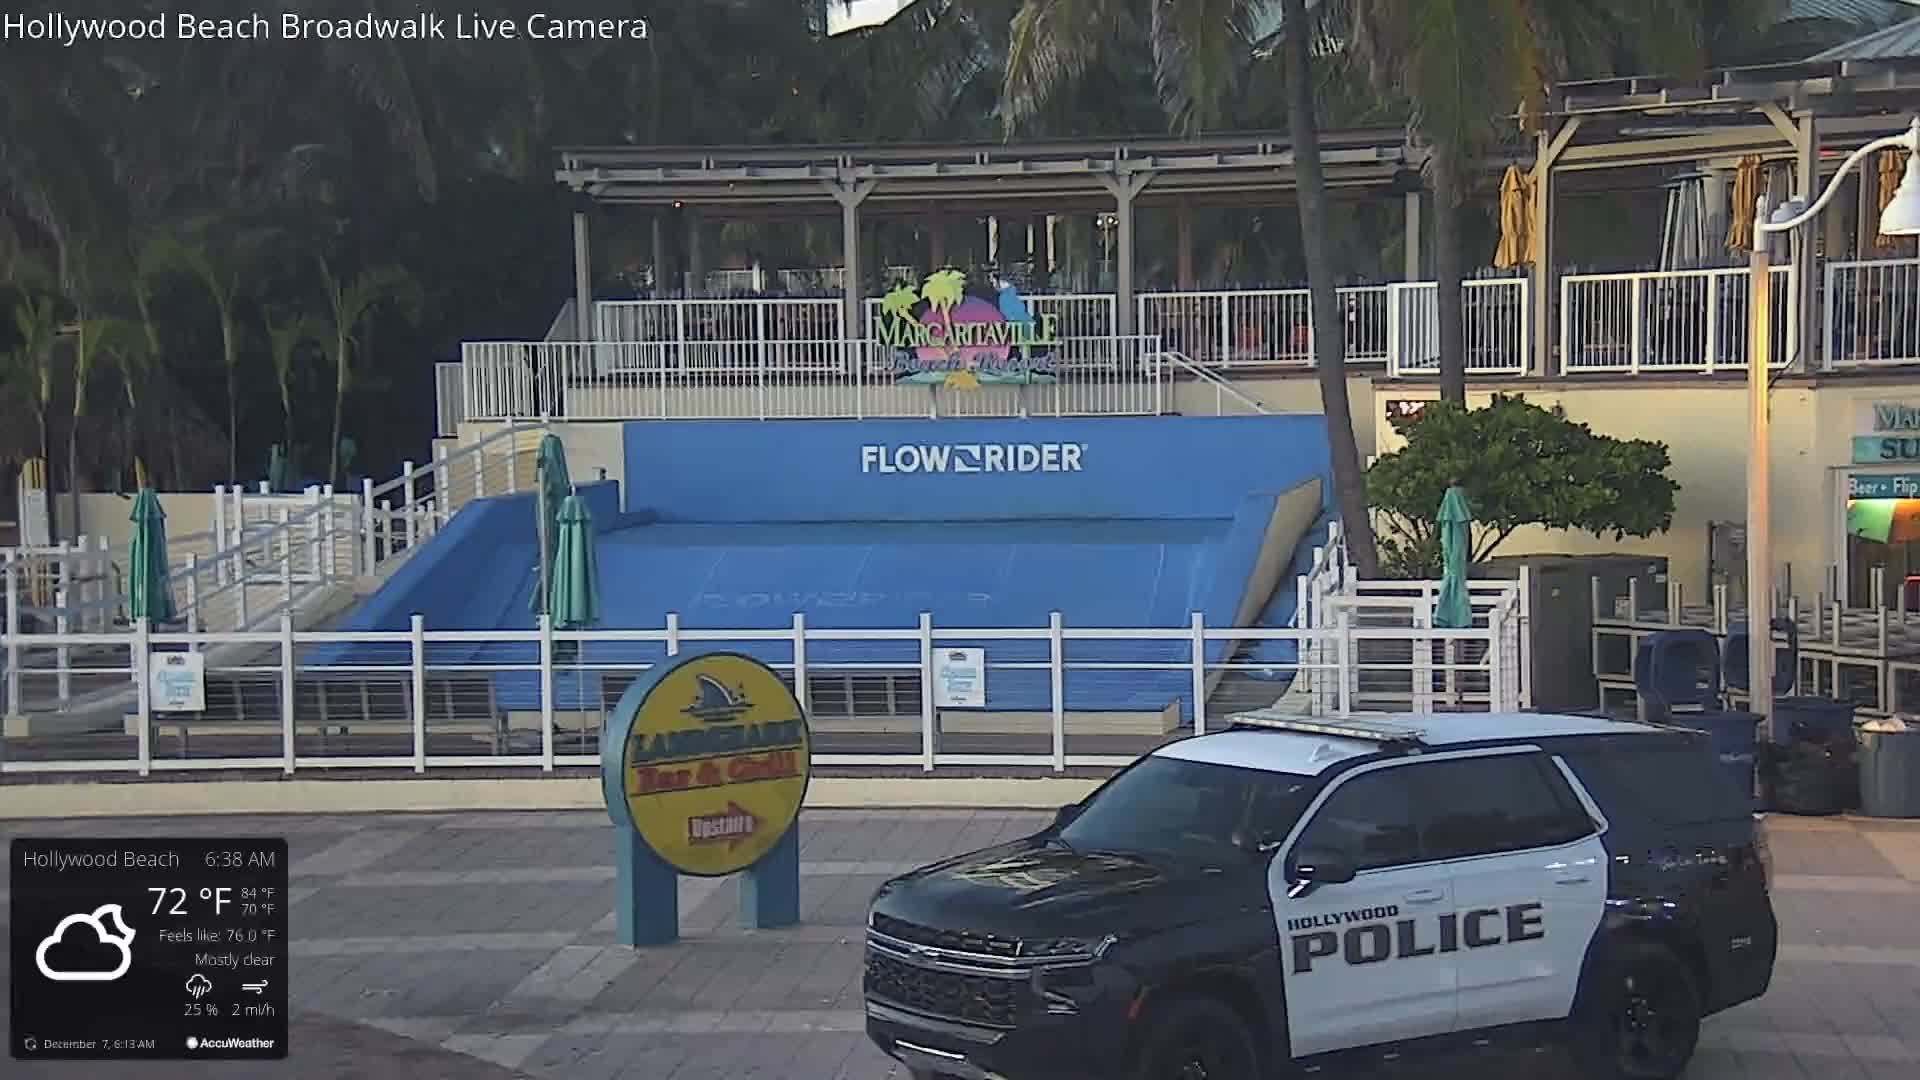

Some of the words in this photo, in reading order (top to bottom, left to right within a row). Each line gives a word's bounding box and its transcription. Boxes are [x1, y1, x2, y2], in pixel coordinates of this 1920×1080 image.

[1850, 476, 1878, 496] Beer
[1893, 477, 1918, 497] Flip
[1288, 905, 1399, 930] HOLLYWOOD
[1291, 902, 1545, 974] POLICE
